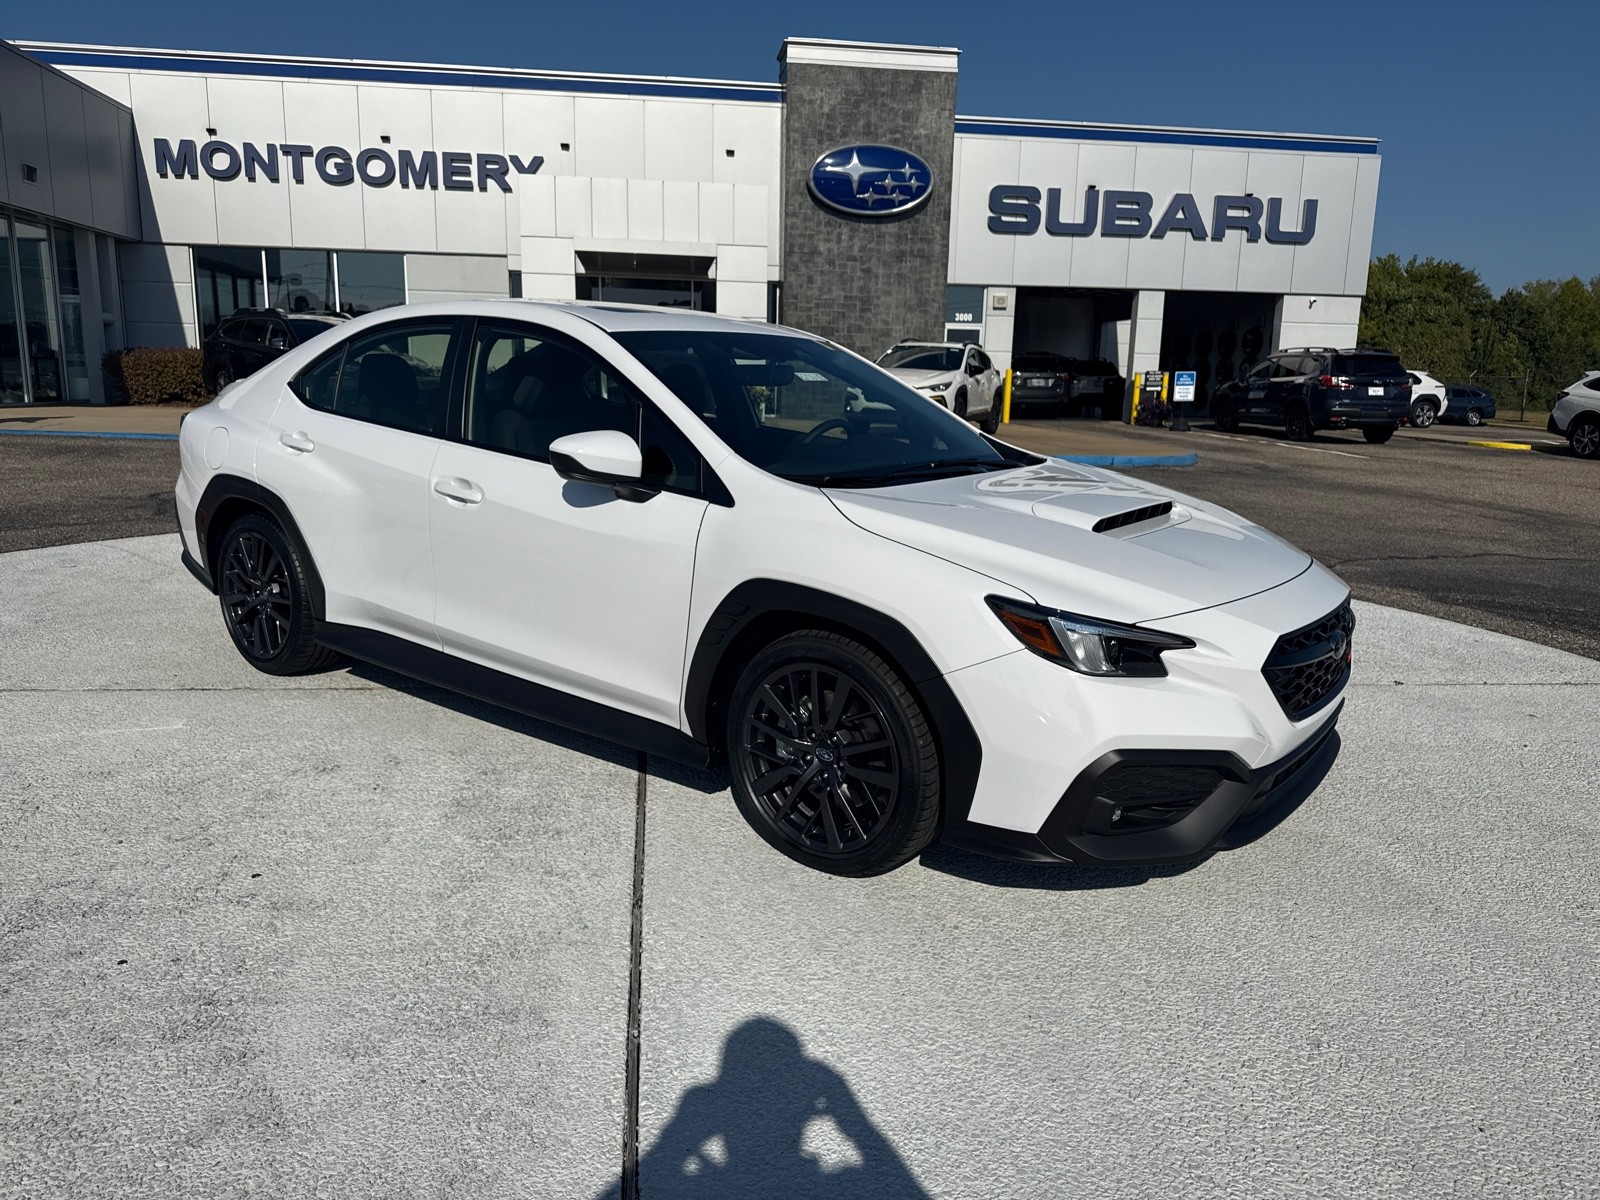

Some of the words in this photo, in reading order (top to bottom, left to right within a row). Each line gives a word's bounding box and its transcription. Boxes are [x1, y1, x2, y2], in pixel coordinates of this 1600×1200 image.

[153, 137, 545, 194] MONTGOMERY
[987, 184, 1319, 246] SUBARU
[954, 312, 973, 322] 3000
